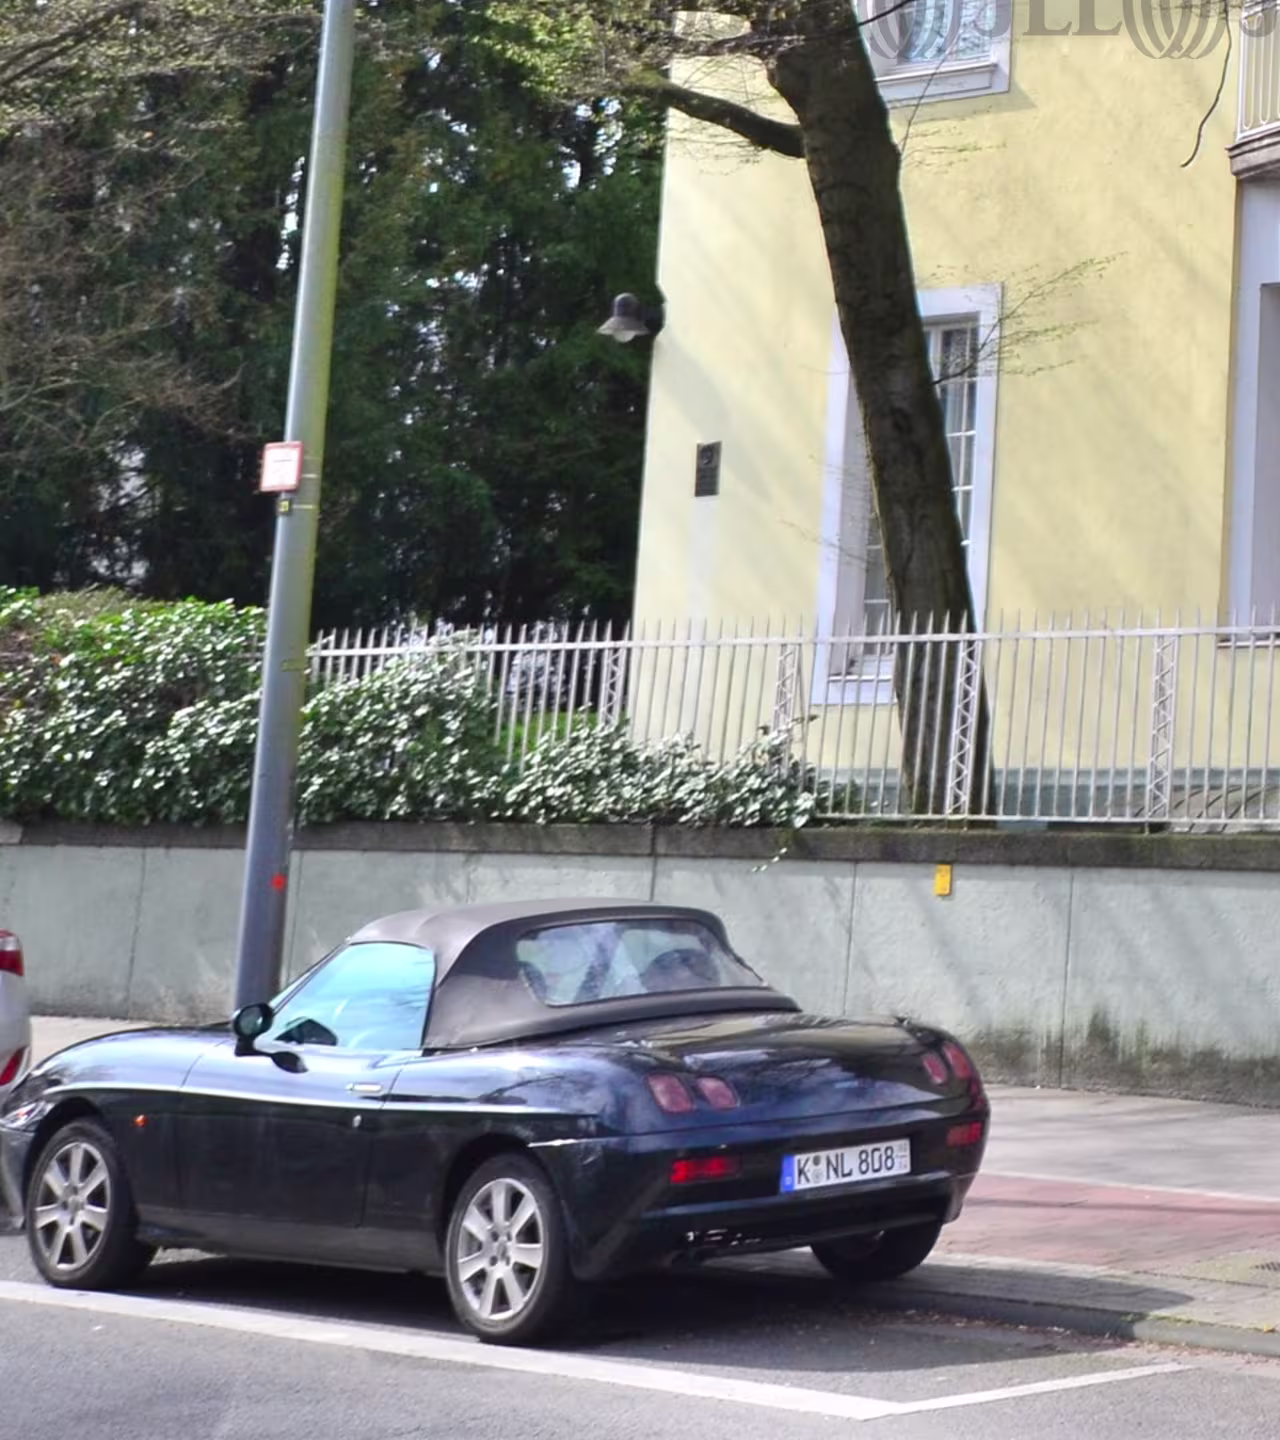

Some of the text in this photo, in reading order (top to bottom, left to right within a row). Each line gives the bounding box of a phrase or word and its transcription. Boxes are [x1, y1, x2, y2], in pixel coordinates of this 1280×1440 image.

[797, 1146, 895, 1185] K NL 808
